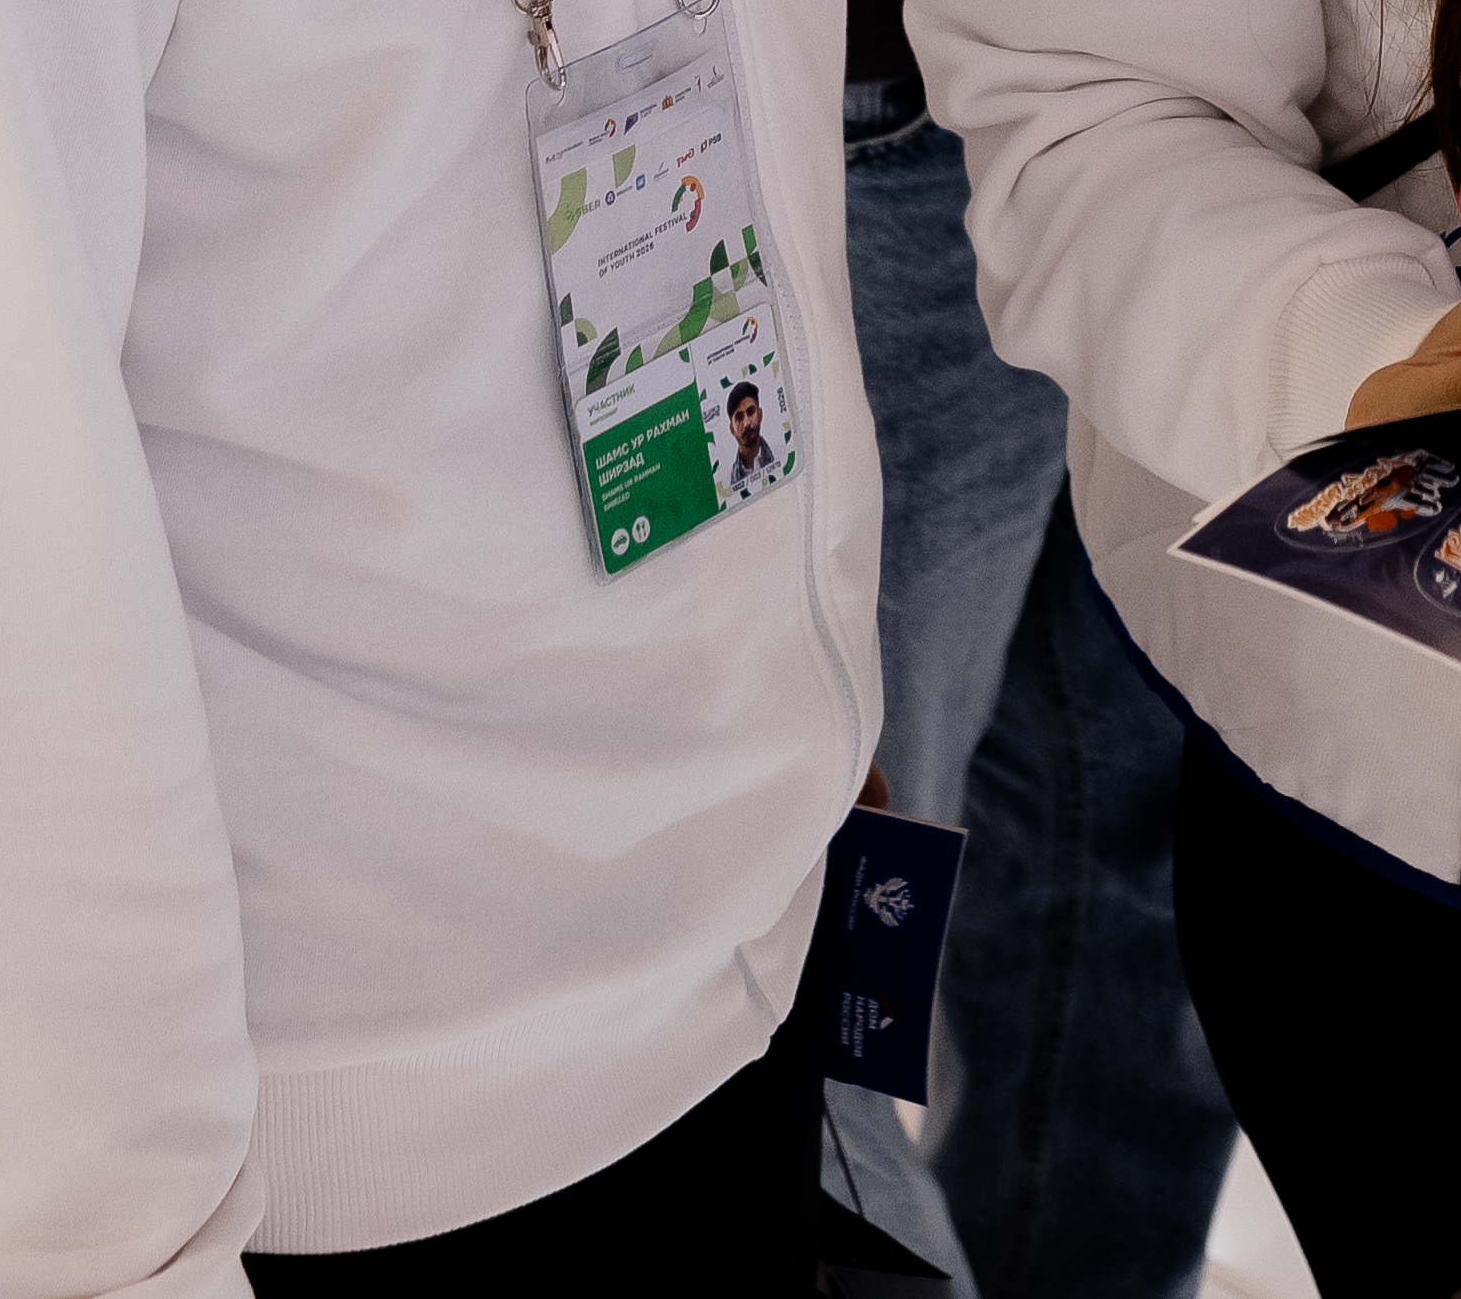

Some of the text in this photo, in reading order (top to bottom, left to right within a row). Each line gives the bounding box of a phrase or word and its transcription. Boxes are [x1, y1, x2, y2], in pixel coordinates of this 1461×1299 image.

[597, 212, 688, 268] INTERNATIONAL FESTIVAL
[598, 241, 655, 278] OF YOUTH 2026
[587, 384, 636, 417] УЧАСТНИК
[595, 444, 630, 470] ШАМС
[631, 433, 645, 450] УР
[646, 408, 690, 442] РАХМАН
[598, 452, 645, 488] ШИРЗАД
[840, 991, 853, 1046] РОССИИ
